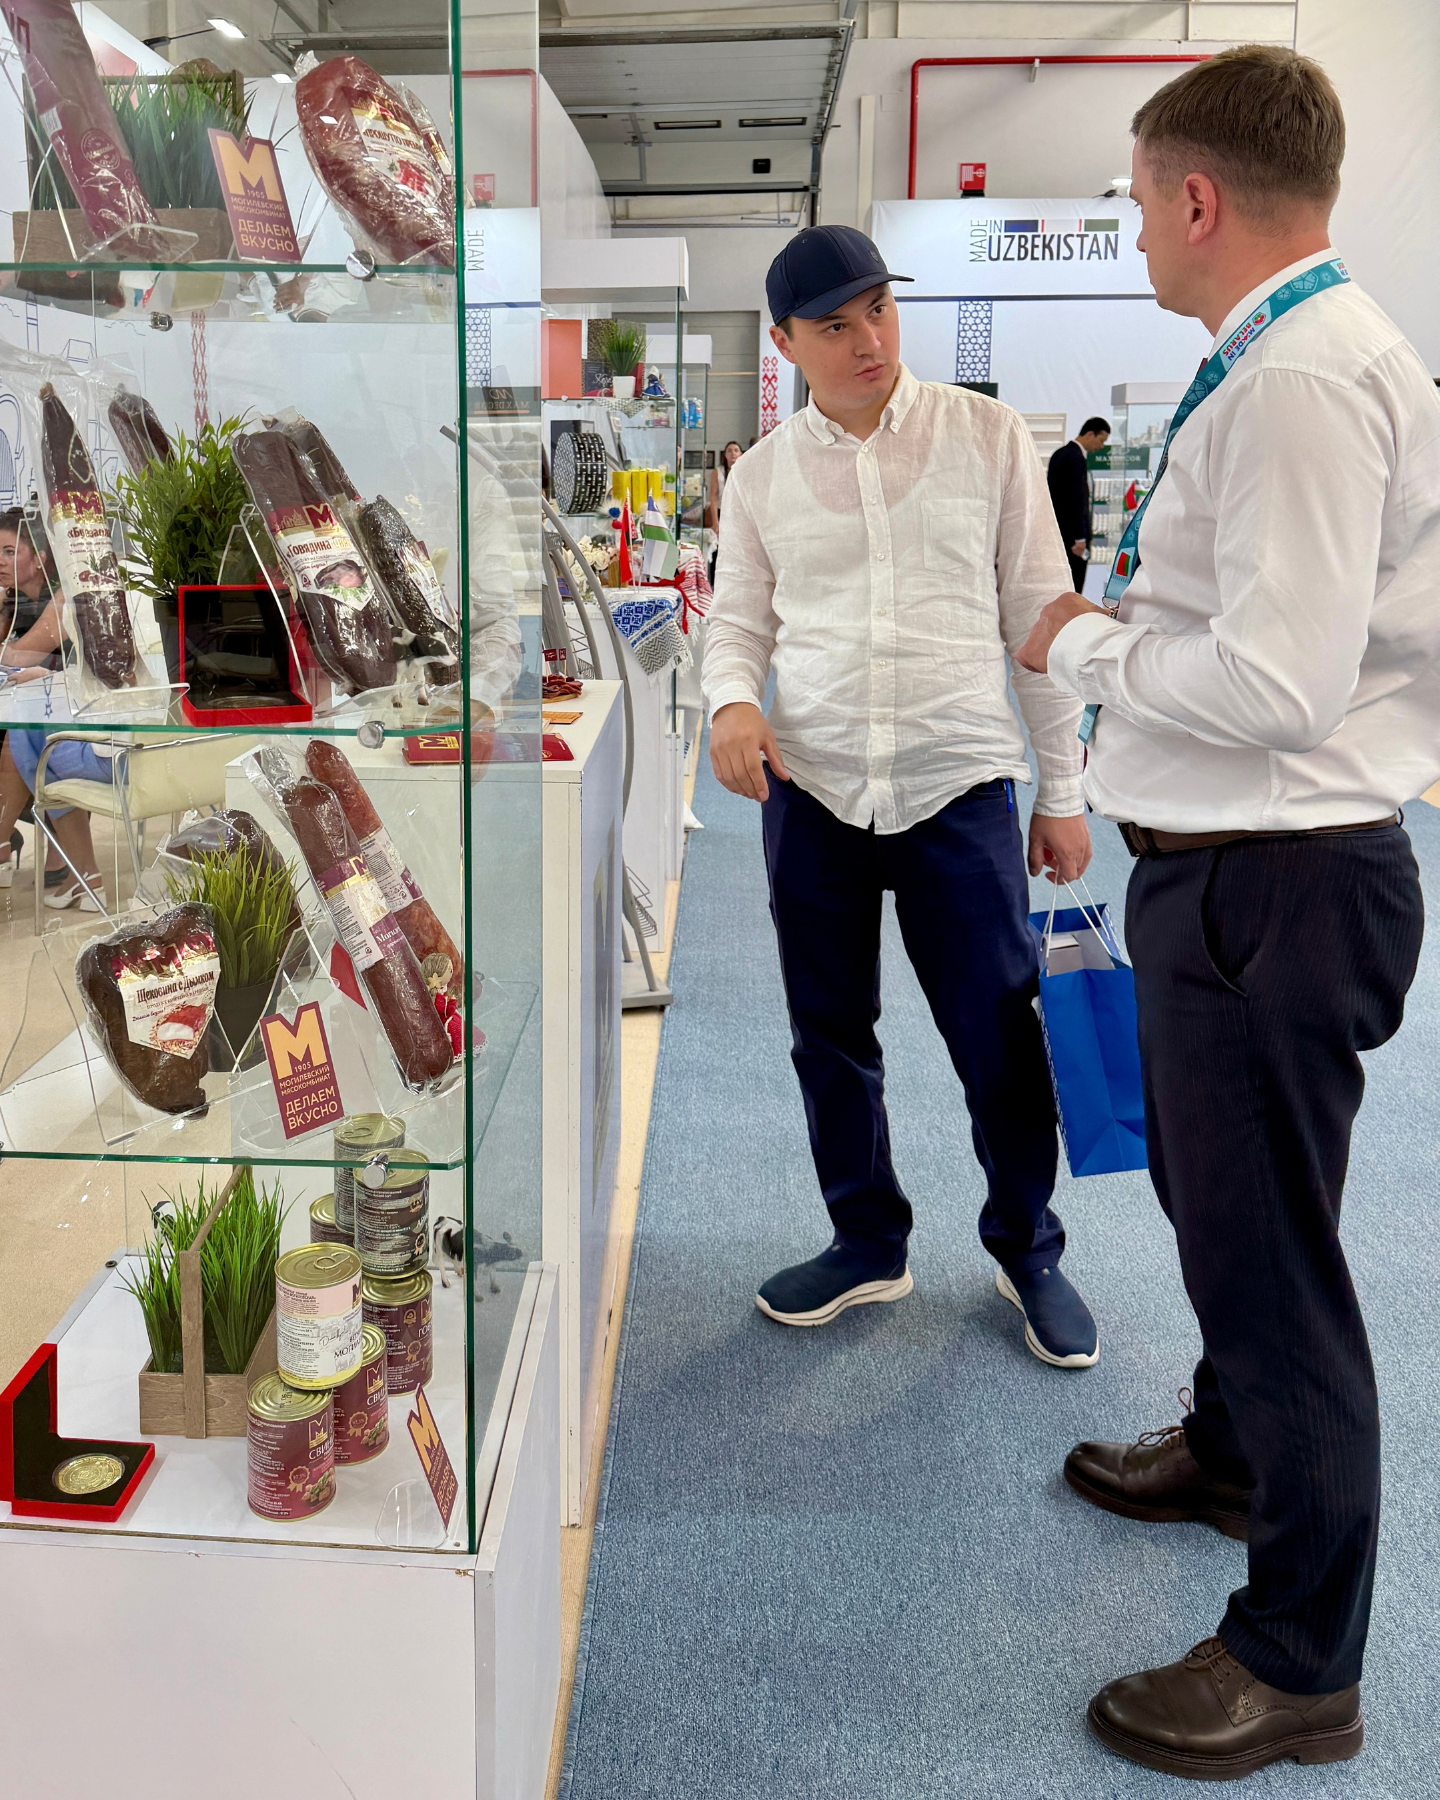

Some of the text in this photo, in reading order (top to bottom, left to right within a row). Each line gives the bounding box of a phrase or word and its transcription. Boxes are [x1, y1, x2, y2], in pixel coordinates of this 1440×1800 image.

[246, 189, 265, 199] 1905
[238, 218, 292, 238] ДЕЛАЕМ
[969, 219, 1003, 263] MADE IN
[241, 234, 295, 252] ВКУСНО
[987, 233, 1119, 262] UZBEKISTAN
[1222, 322, 1252, 357] BELARUS
[136, 984, 179, 1003] Щековина
[183, 971, 215, 993] Дымком
[279, 1064, 330, 1089] МОГИЛЕВСКИЙ
[294, 1061, 312, 1073] 1905
[281, 1073, 331, 1096] МЯСОКОМБИНАТ
[285, 1085, 336, 1117] ДЕЛАЕМ
[288, 1100, 338, 1130] ВКУСНО
